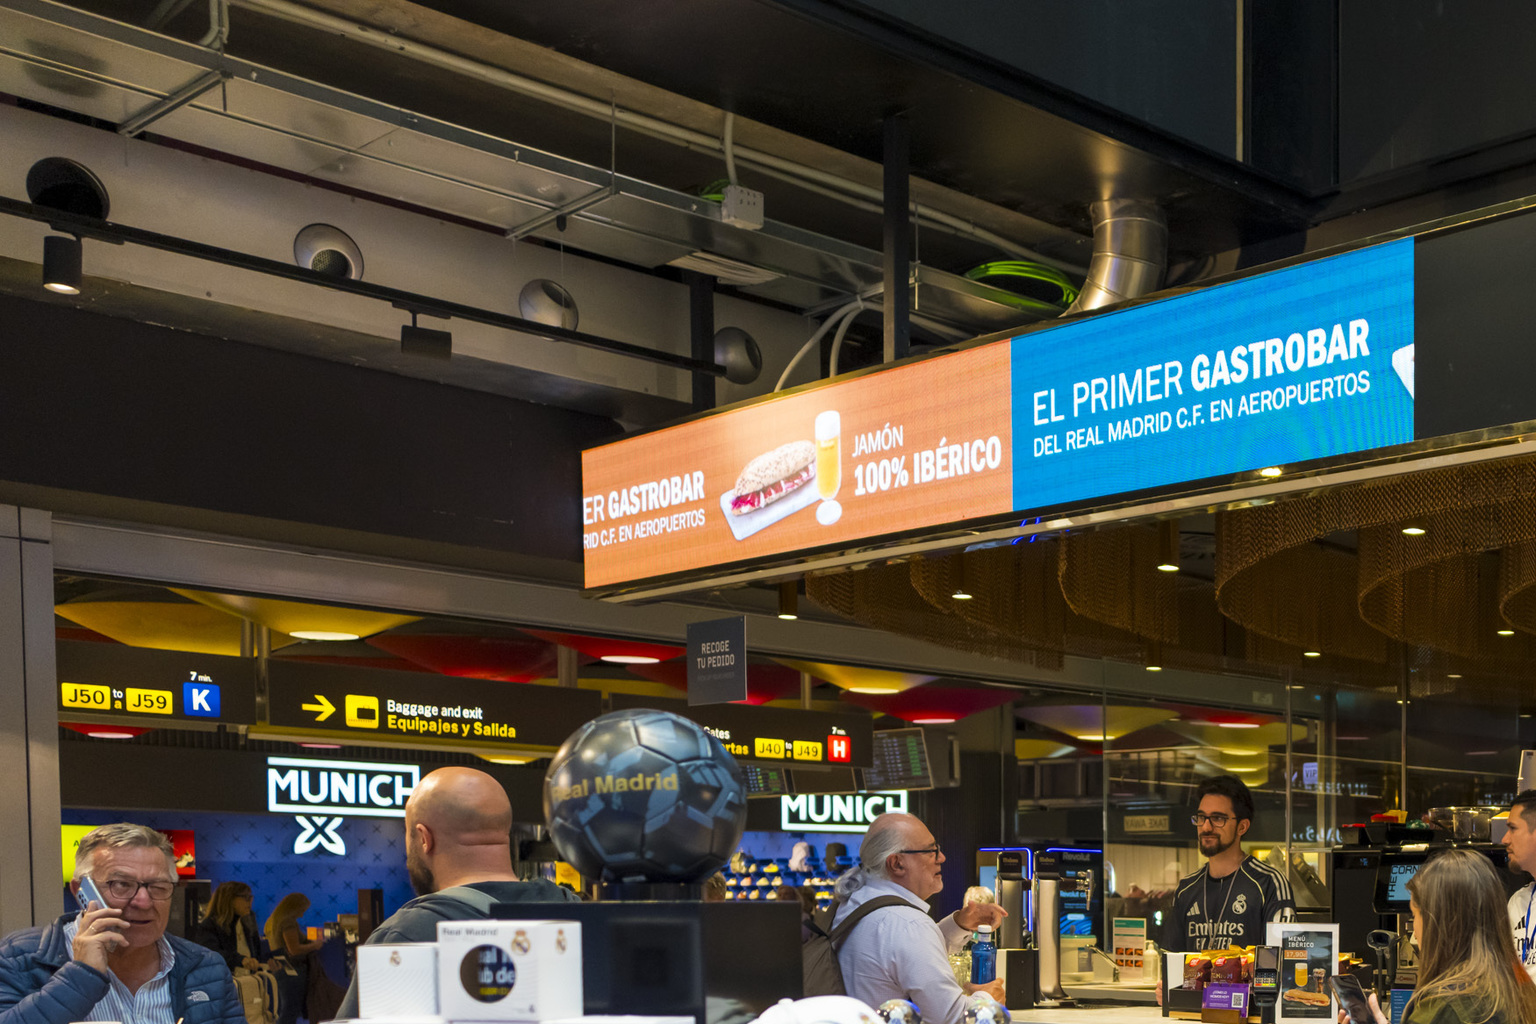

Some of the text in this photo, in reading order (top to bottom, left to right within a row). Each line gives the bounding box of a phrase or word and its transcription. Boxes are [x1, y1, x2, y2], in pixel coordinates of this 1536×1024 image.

[1034, 318, 1370, 426] EL PRIMER GASTROBAR
[1034, 370, 1371, 458] DEL REAL MADRID C.F. EN AEROPUERTOS
[851, 423, 904, 457] JAMÓN
[854, 436, 1002, 496] 100% IBÉRICO
[608, 470, 706, 518] GASTROBAR
[600, 528, 617, 549] C.F.
[619, 524, 633, 543] EN
[634, 509, 706, 540] AEROPUERTOS
[701, 640, 730, 655] RECOGE
[697, 654, 735, 669] TU PEDIDO
[190, 671, 198, 681] 7
[68, 689, 105, 705] J50
[112, 688, 124, 699] to
[132, 694, 167, 709] J59
[192, 688, 212, 712] K
[114, 700, 123, 710] a
[387, 699, 484, 720] Baggage and exit
[387, 714, 517, 738] Equipajes y Salida
[832, 726, 837, 735] 7
[759, 742, 782, 755] J40
[785, 742, 793, 750] to
[786, 750, 792, 758] a
[797, 745, 818, 758] J49
[833, 739, 846, 758] H
[267, 764, 420, 812] MUNICH
[594, 773, 678, 794] Madrid
[781, 791, 908, 827] MUNICH
[1062, 852, 1090, 861] Revolut
[1391, 865, 1420, 875] CORN
[1388, 875, 1398, 898] THE
